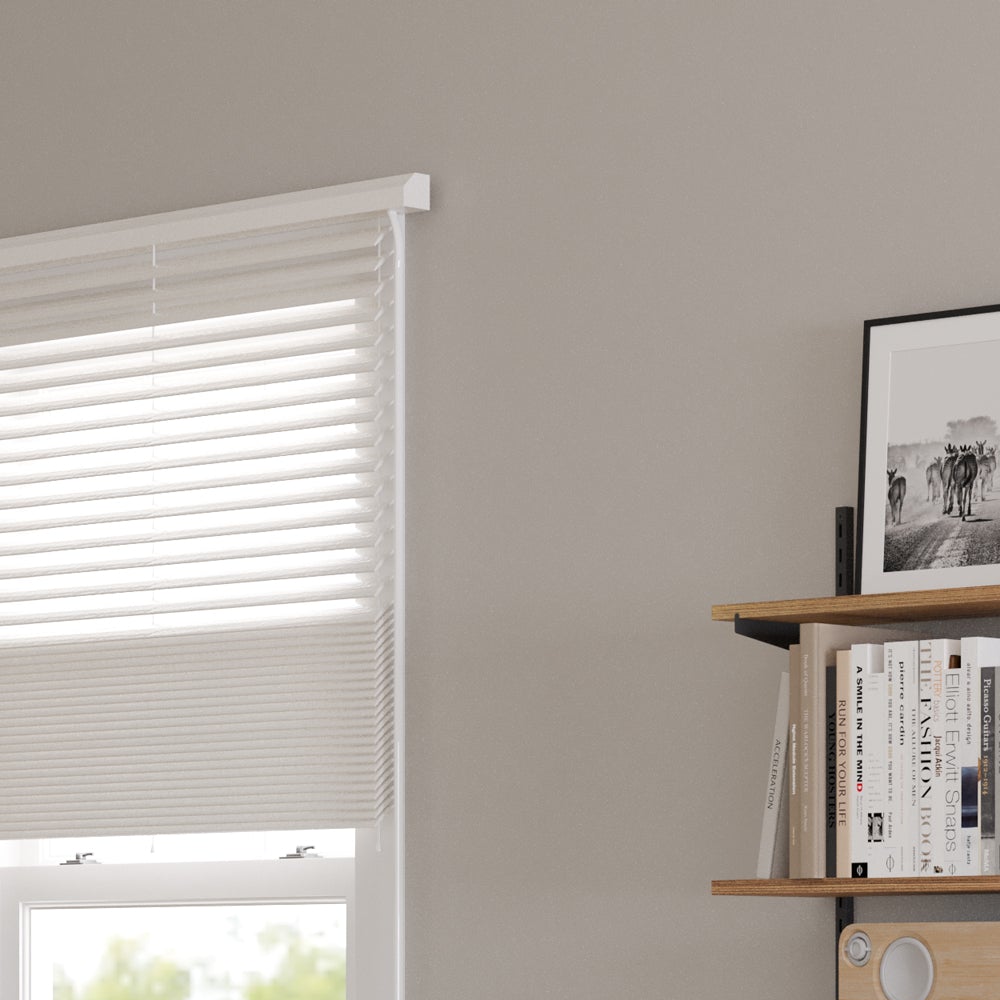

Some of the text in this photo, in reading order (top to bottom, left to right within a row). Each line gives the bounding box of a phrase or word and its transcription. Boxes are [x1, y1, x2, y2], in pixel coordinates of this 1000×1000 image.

[856, 718, 863, 730] IN
[933, 661, 941, 722] POTTERY basics
[983, 679, 992, 751] Picasso Guitars
[767, 739, 782, 809] ACCELERATION
[828, 713, 836, 828] YOUNG HOSTERS
[838, 700, 847, 826] RUN FOR YOUR LIFE
[911, 770, 917, 782] OF
[920, 642, 932, 872] THE FASHION BOOK
[934, 736, 942, 777] Jacqui Atkin
[944, 674, 959, 852] Elliott Erwitt Snaps
